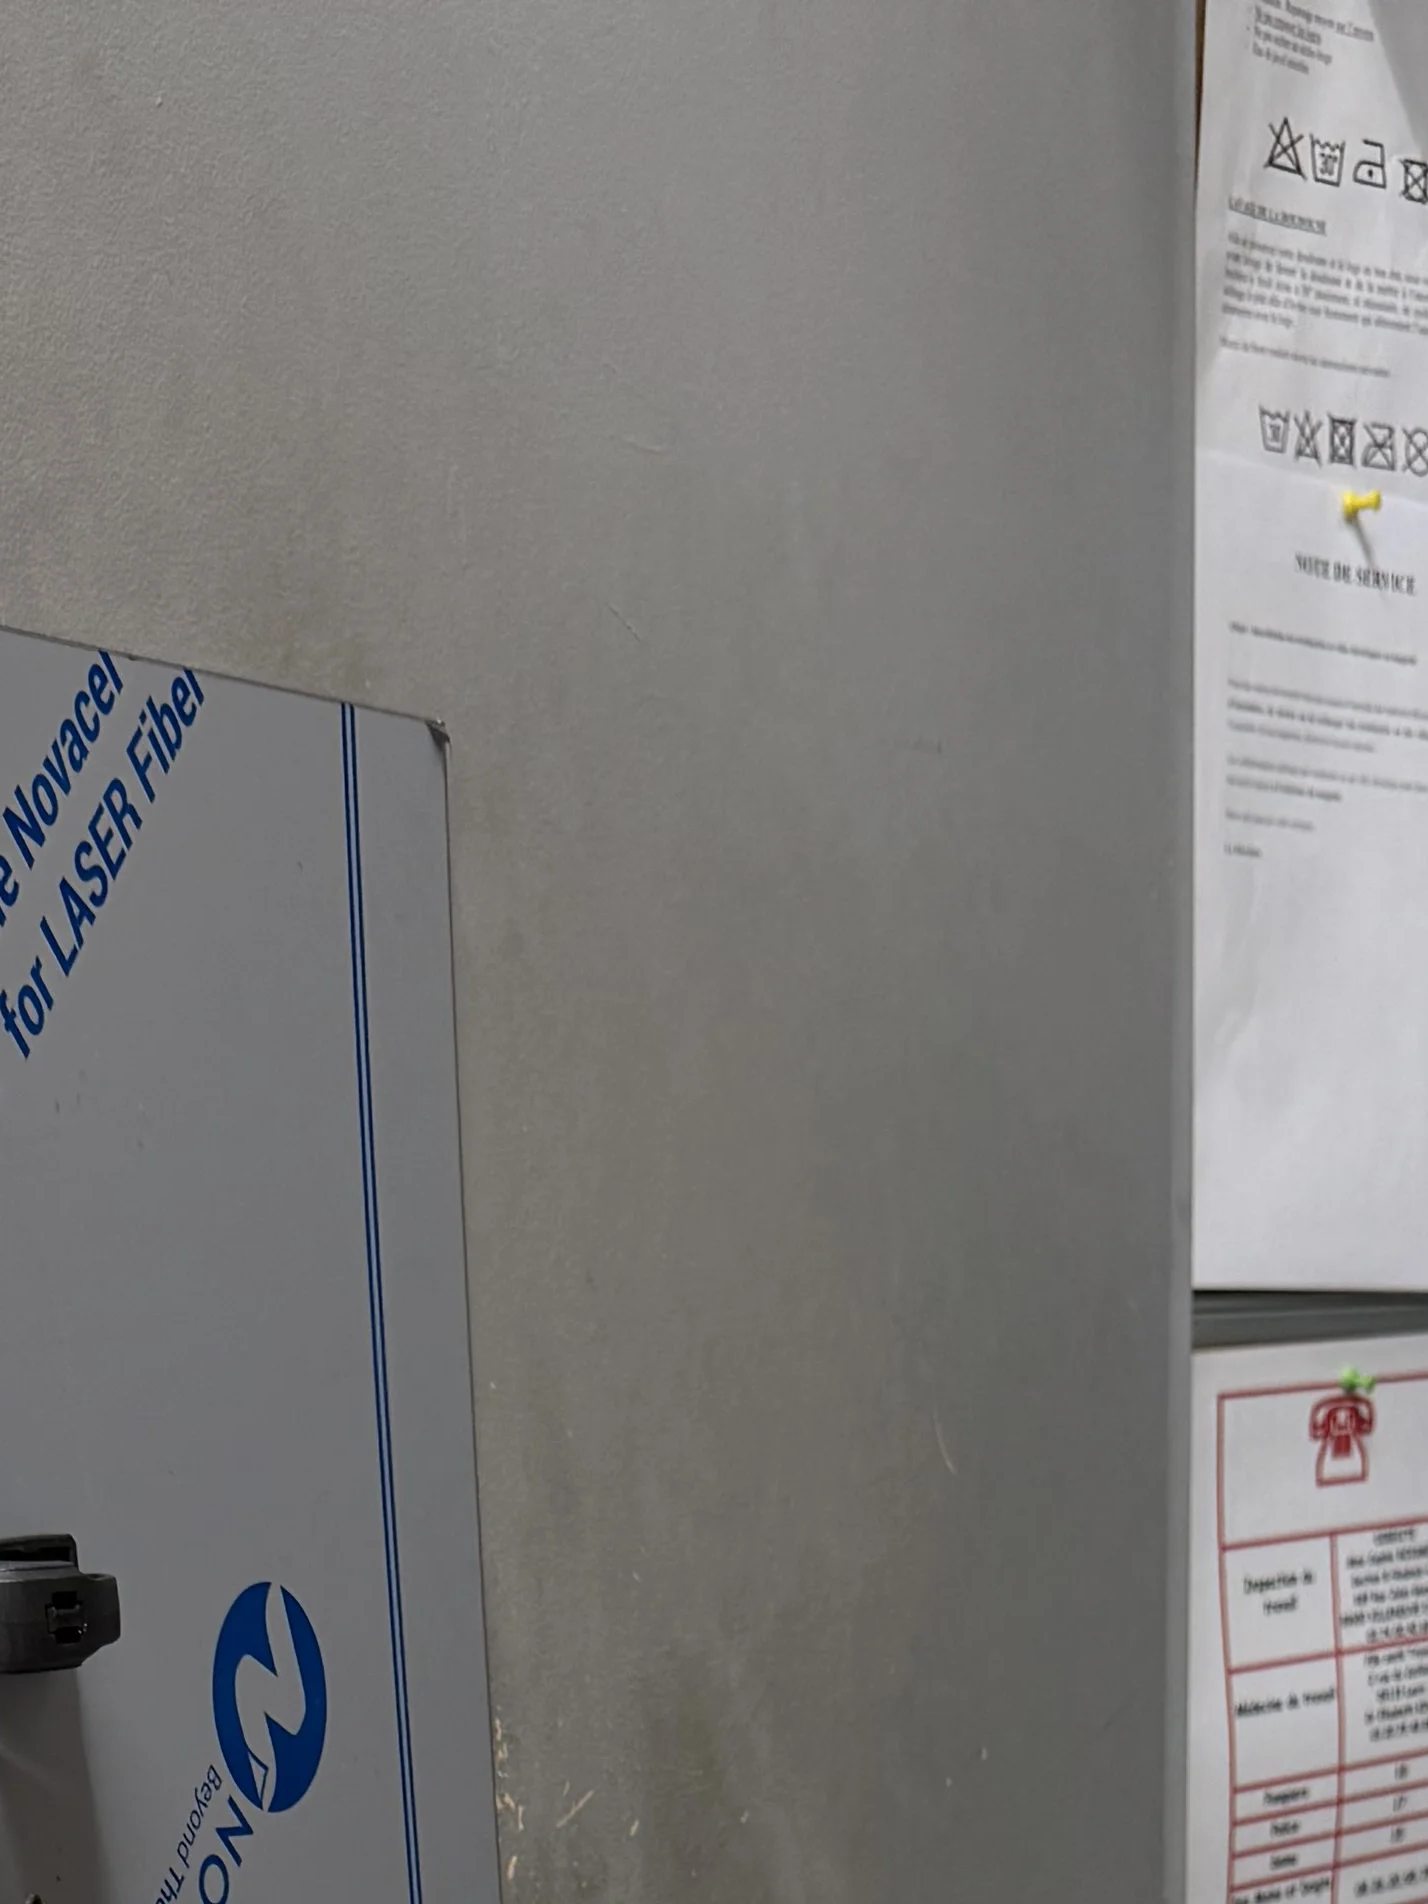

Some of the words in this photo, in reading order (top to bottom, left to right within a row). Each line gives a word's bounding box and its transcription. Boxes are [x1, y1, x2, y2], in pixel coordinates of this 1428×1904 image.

[2, 648, 124, 870] Novacel
[39, 777, 143, 978] LASER
[175, 1762, 223, 1870] Beyond
